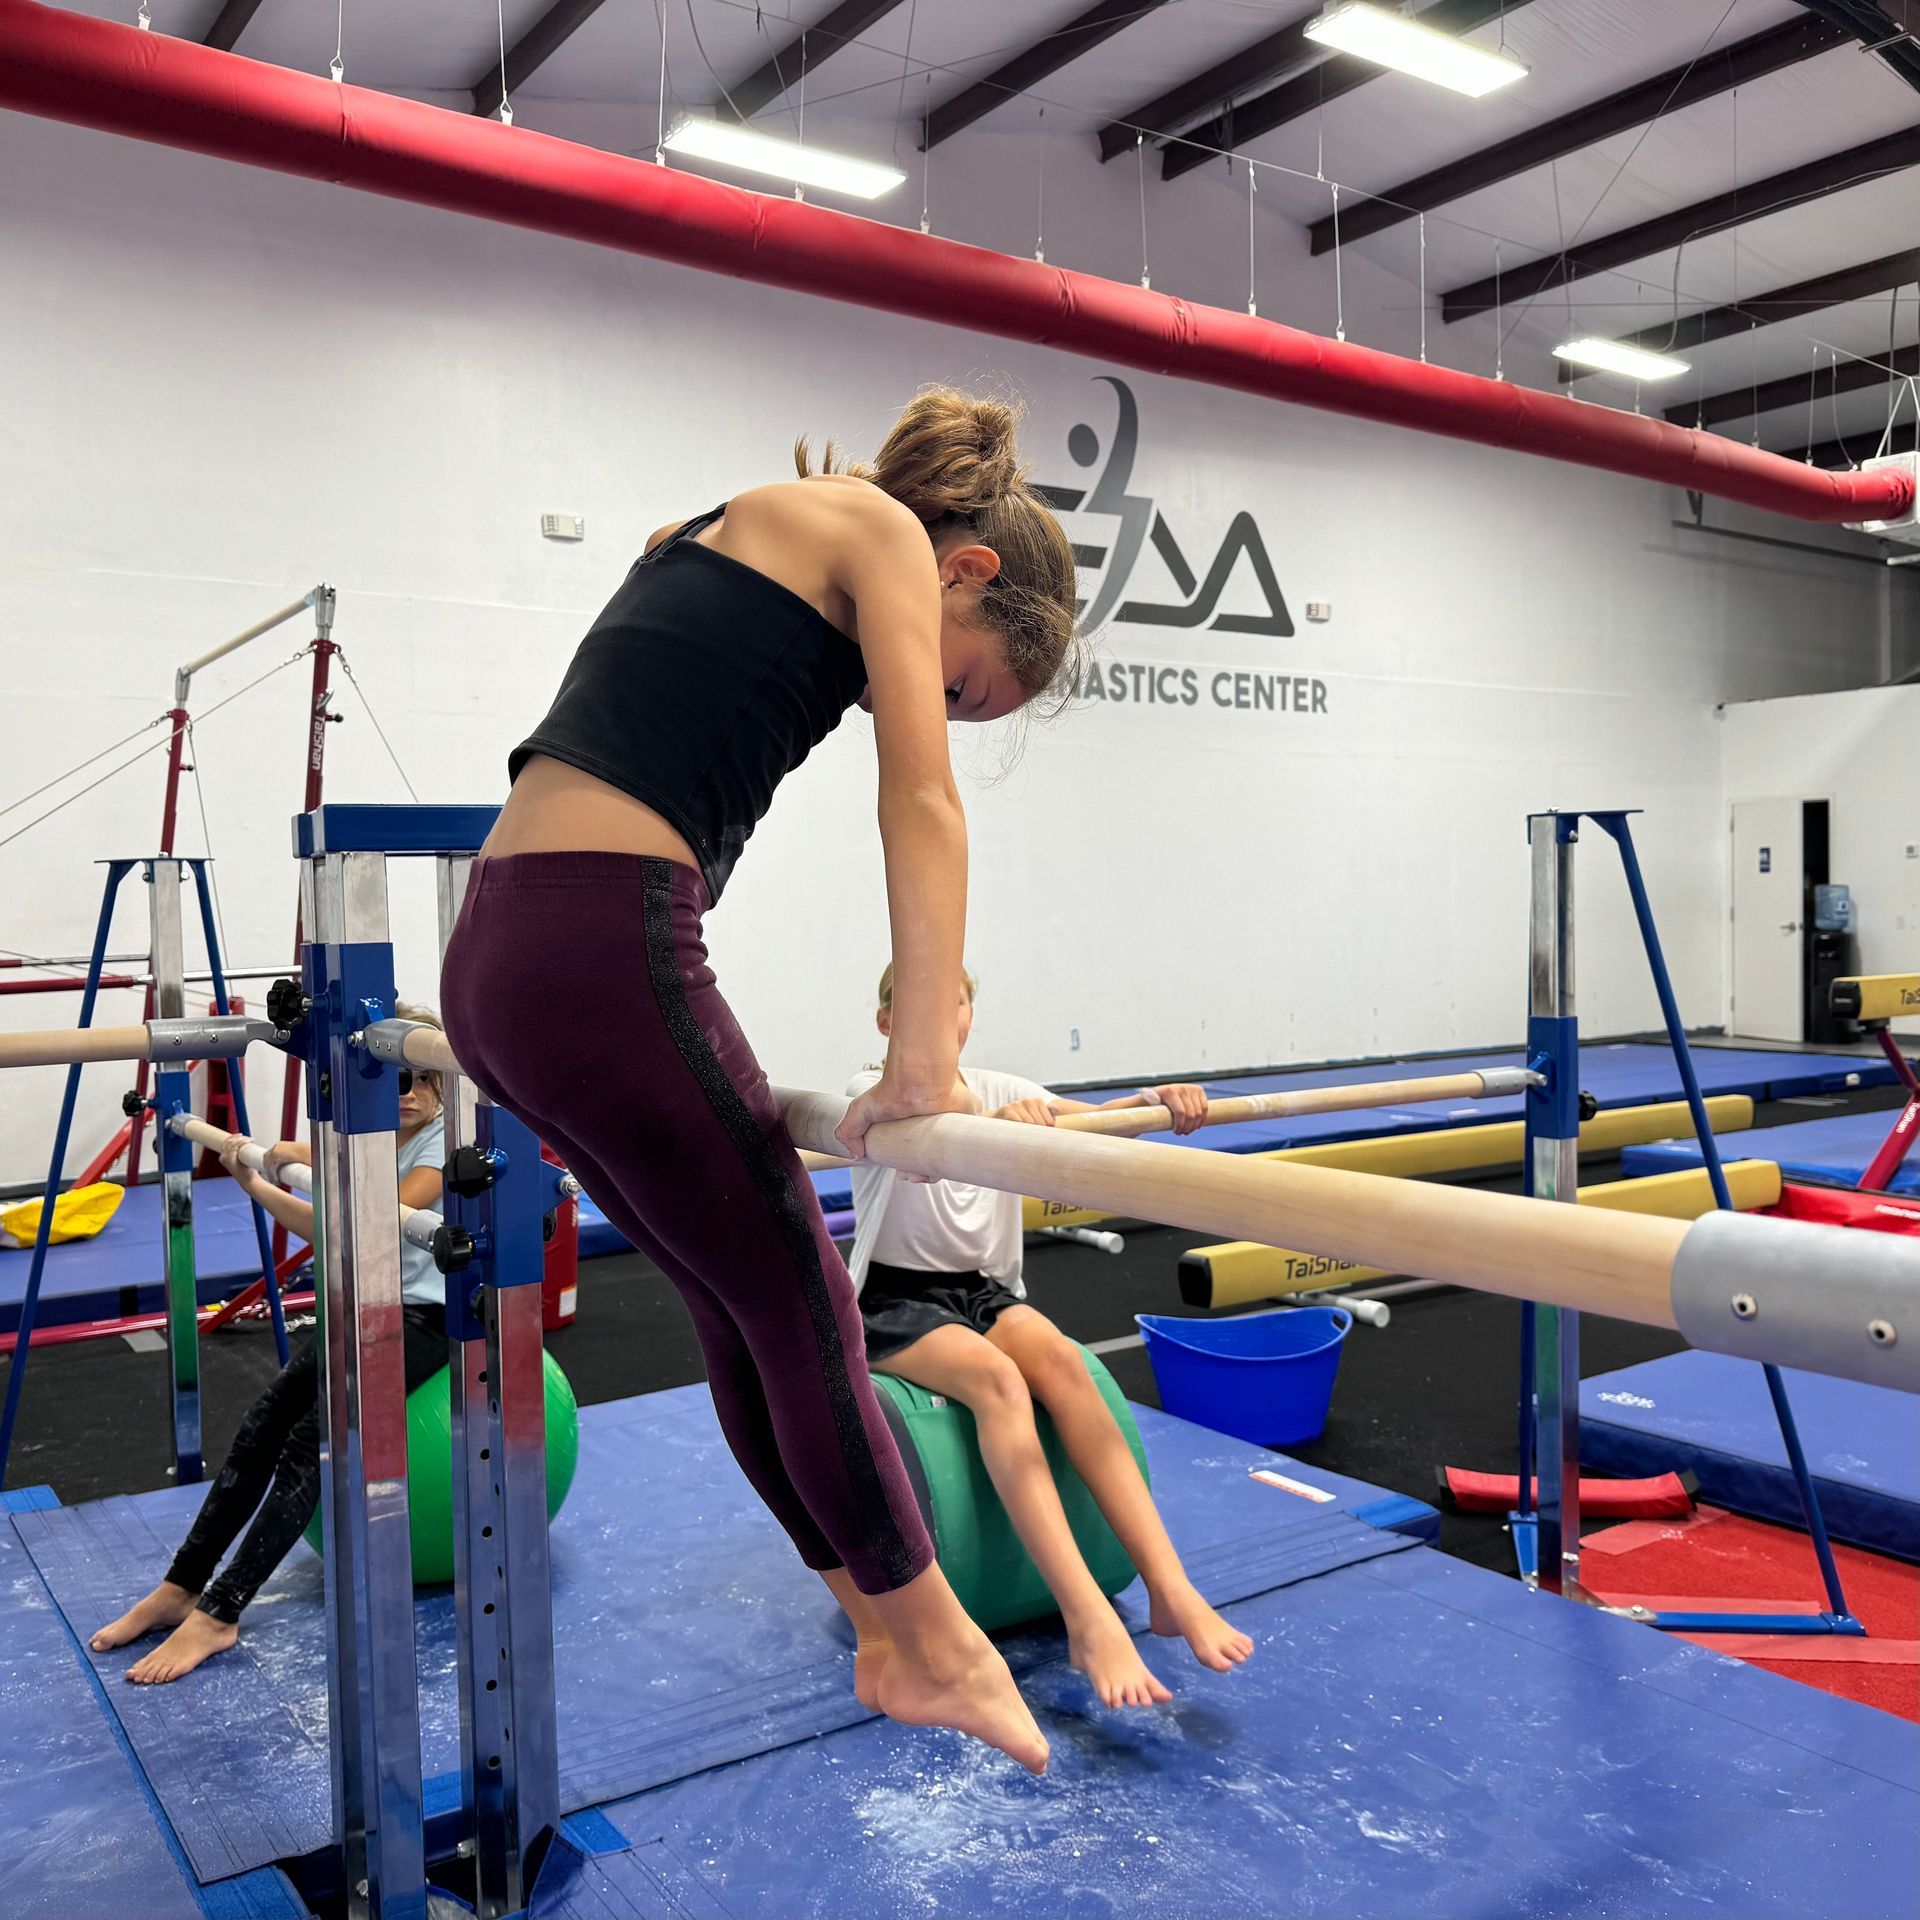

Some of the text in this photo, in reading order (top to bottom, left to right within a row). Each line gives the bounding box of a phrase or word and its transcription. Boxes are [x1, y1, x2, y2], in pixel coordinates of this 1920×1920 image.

[1062, 661, 1328, 714] ASTICS CENTER
[311, 715, 326, 771] TaiShan
[1284, 1255, 1356, 1280] TaiSha
